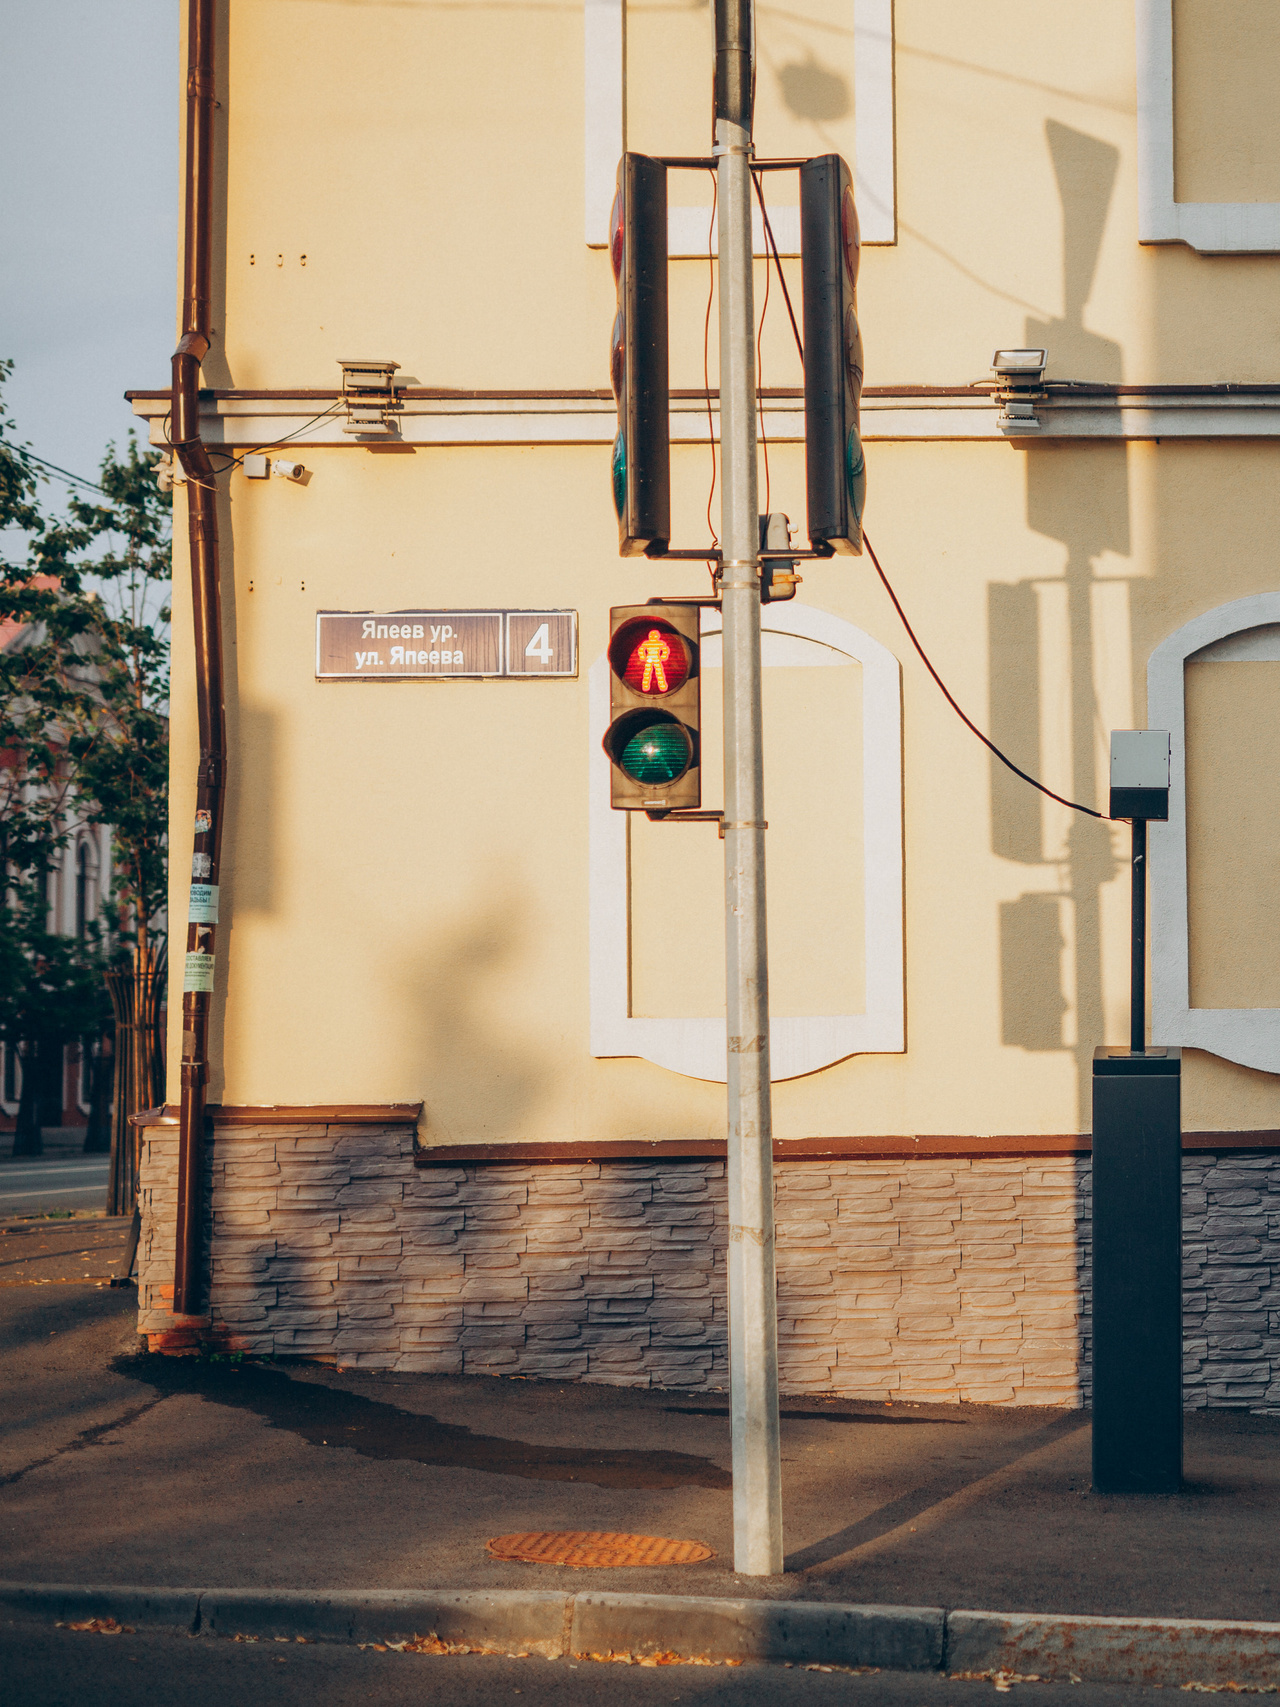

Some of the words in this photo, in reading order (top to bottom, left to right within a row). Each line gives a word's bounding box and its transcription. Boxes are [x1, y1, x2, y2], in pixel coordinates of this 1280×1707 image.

[361, 620, 424, 639] Япеев
[430, 624, 458, 643] ур.
[525, 623, 553, 664] 4
[355, 651, 384, 669] ул.
[390, 646, 464, 665] Япеева
